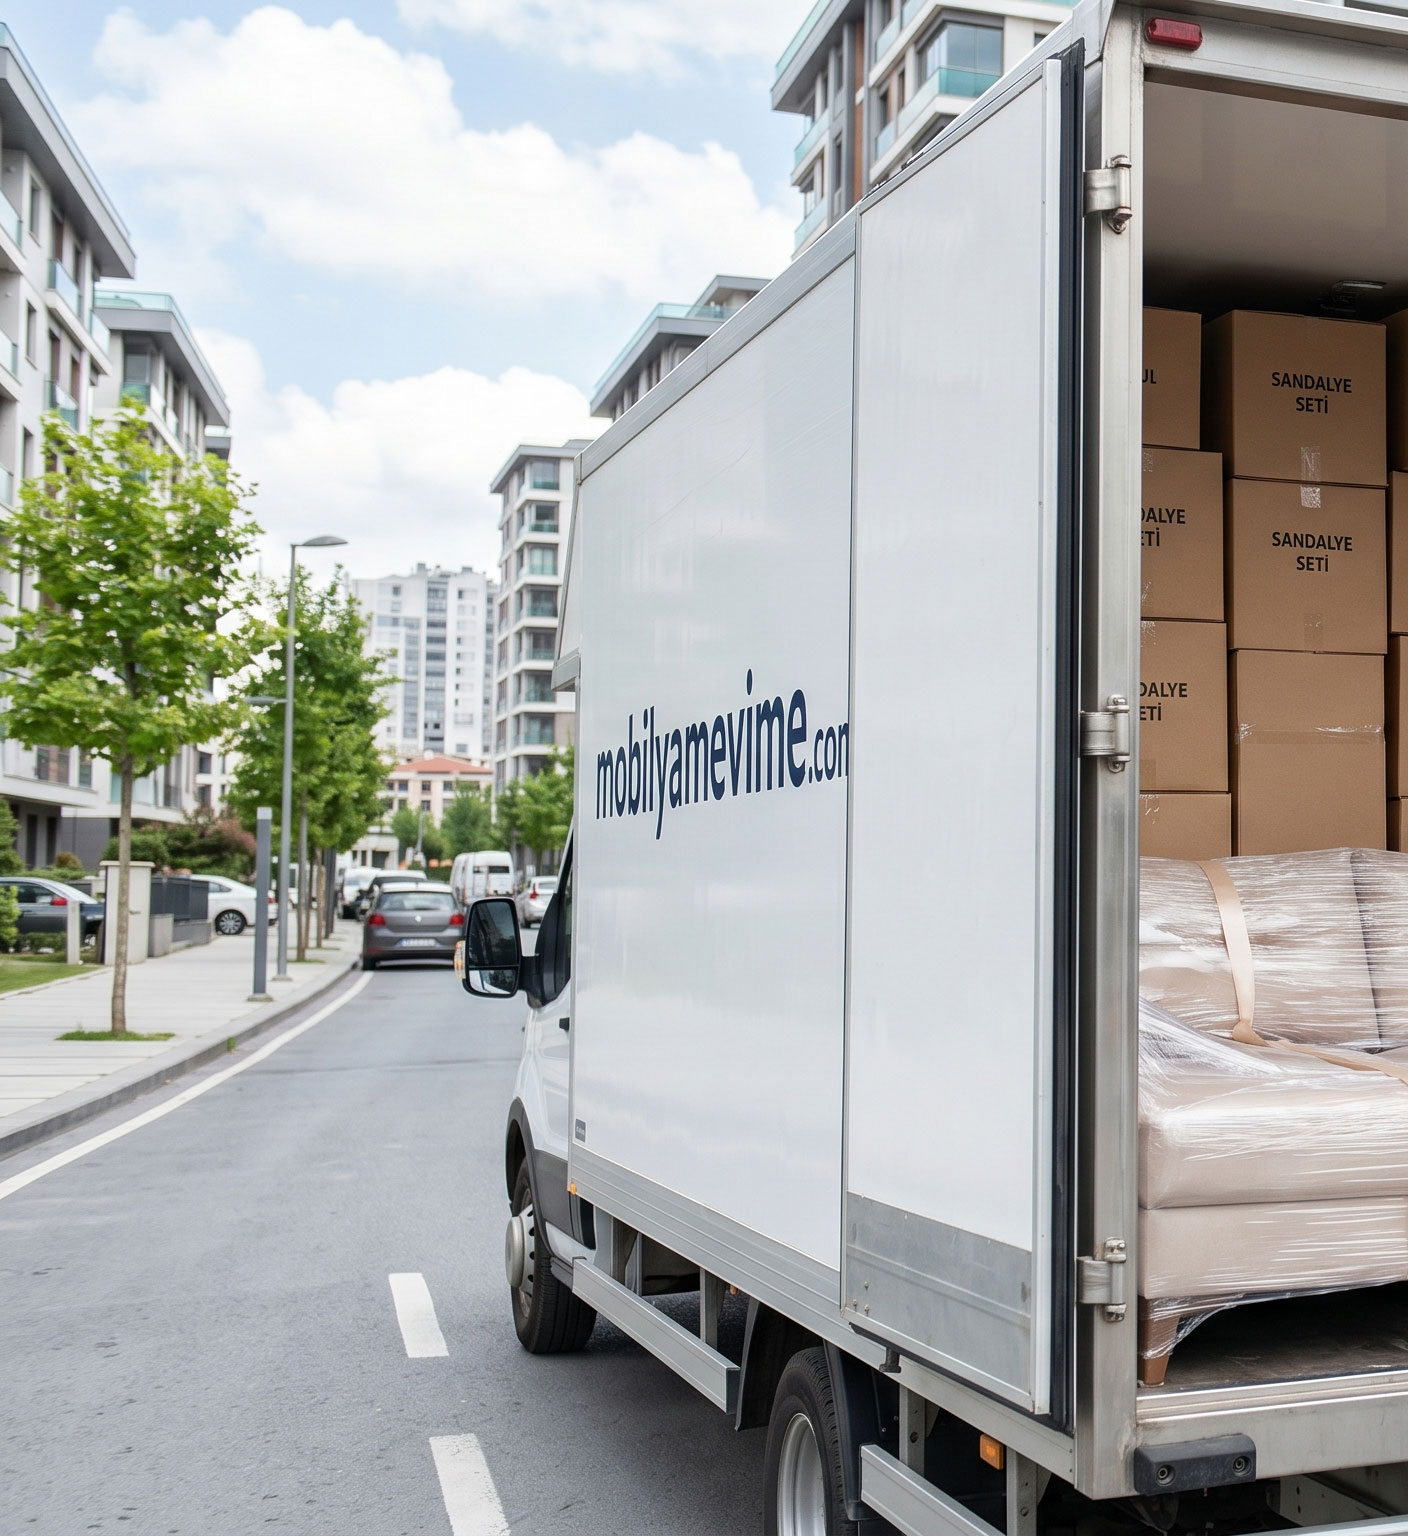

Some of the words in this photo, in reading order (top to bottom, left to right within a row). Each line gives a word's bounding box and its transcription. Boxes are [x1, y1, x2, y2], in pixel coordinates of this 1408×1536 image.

[1271, 371, 1352, 394] SANDALYE
[1295, 395, 1329, 414] SETİ
[1271, 531, 1353, 552] SANDALYE
[1296, 554, 1329, 573] SETİ
[1140, 681, 1188, 698] DALYE
